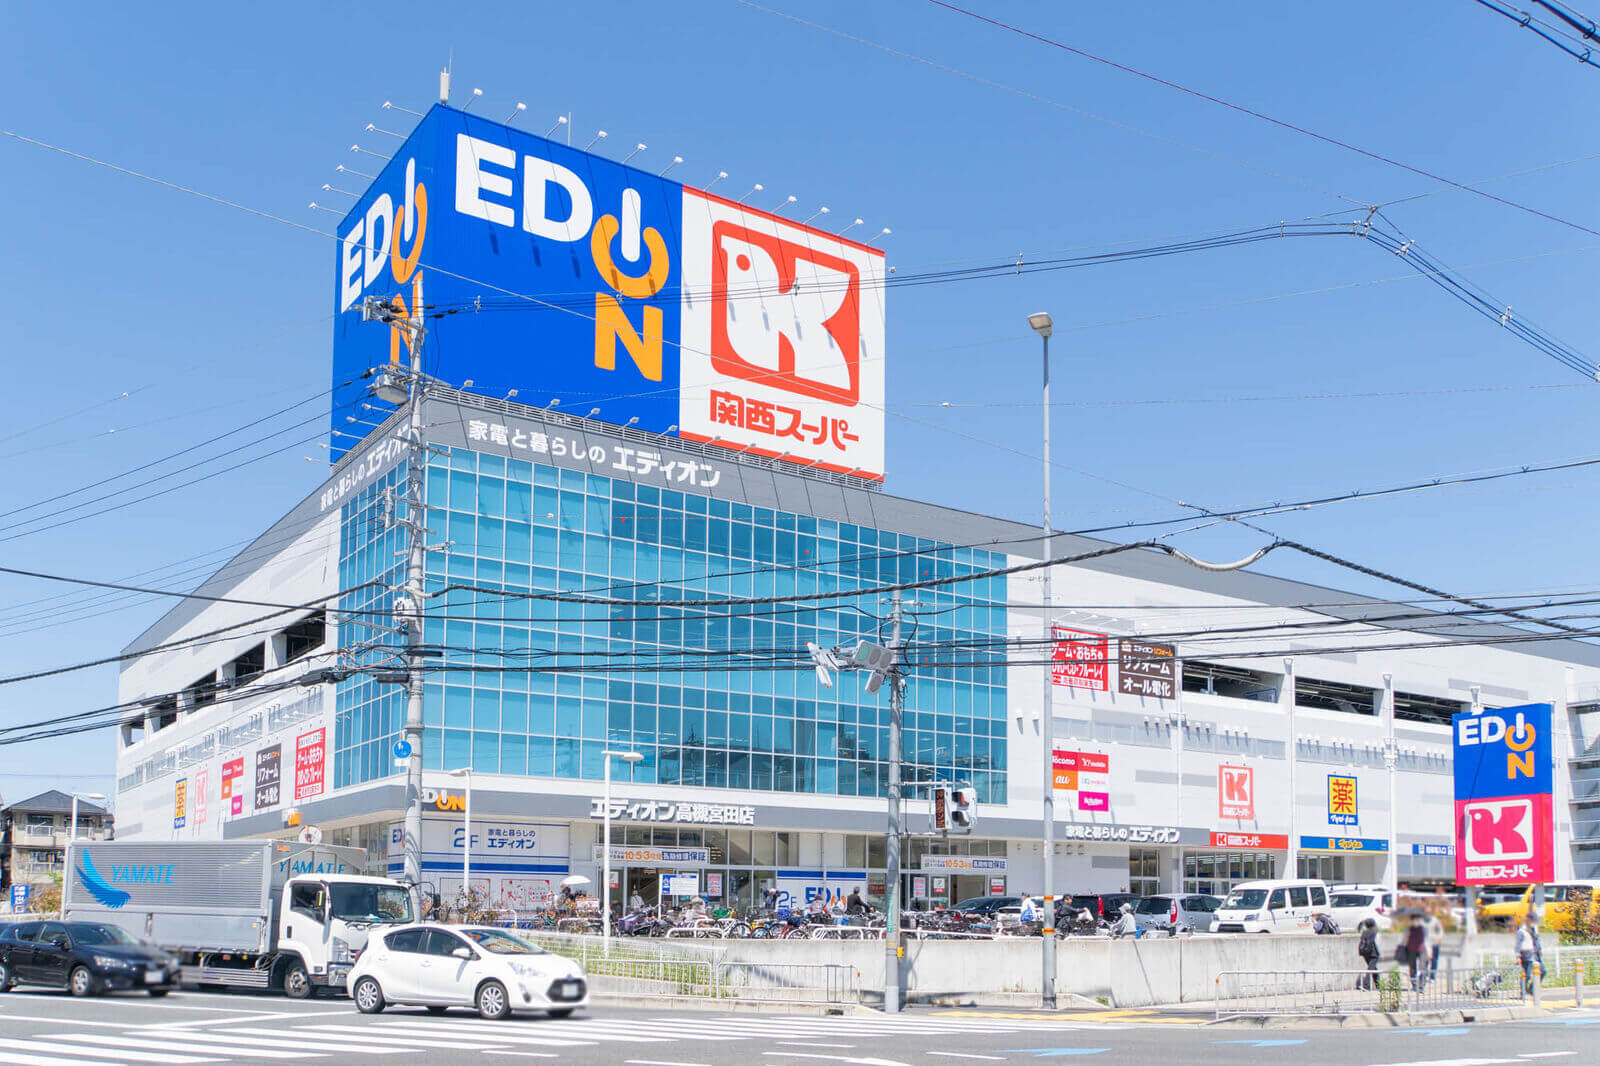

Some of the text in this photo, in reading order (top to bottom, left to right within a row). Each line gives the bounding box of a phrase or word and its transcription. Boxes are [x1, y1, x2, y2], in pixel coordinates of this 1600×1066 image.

[455, 131, 670, 383] EDION
[710, 389, 859, 452] 関西スーパー
[468, 419, 721, 487] 家電と暮らしの エディオン
[1123, 677, 1171, 697] オール電化
[1458, 712, 1537, 780] EDION
[1332, 778, 1353, 813] 薬
[488, 838, 535, 849] エディオン
[1128, 826, 1181, 844] エディオン
[112, 864, 177, 885] YAMATE
[1465, 863, 1534, 880] 関西スーパー
